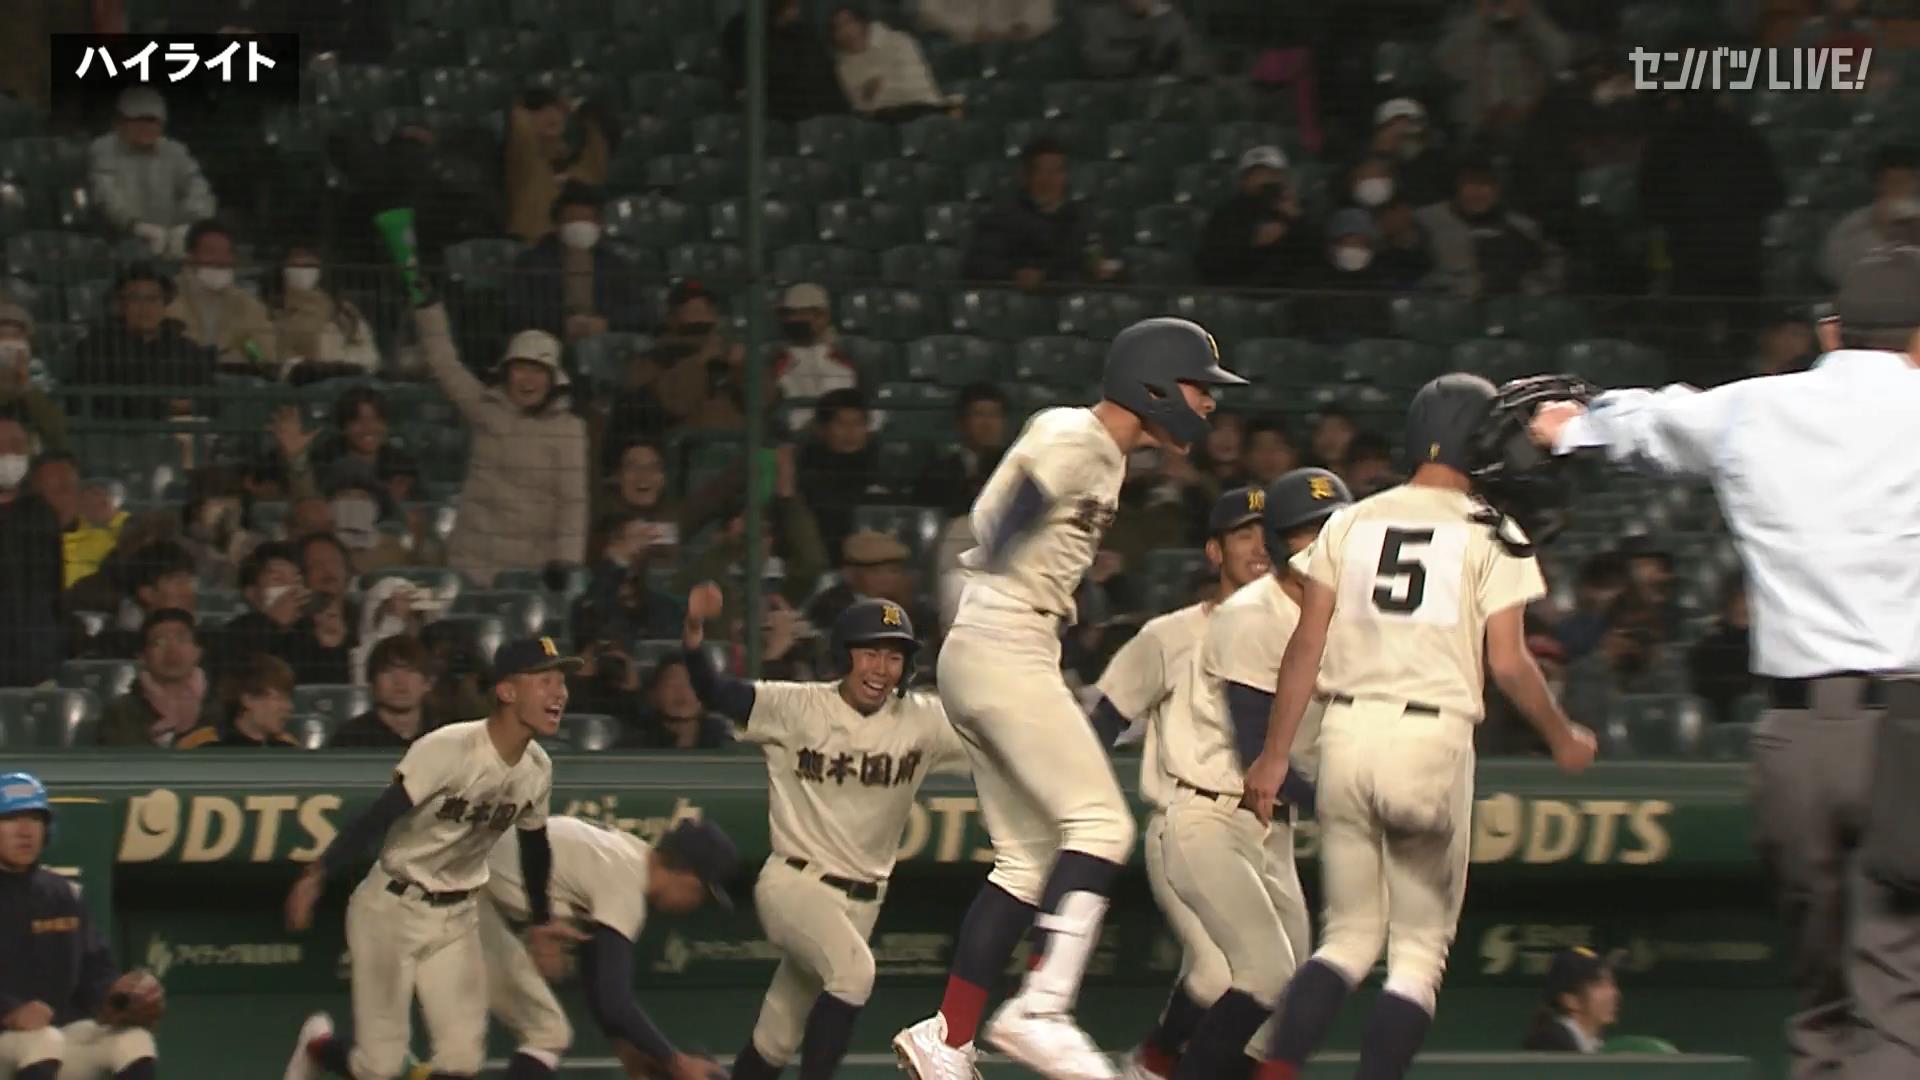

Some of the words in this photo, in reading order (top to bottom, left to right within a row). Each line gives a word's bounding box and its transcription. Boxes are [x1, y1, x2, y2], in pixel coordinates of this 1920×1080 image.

[1371, 526, 1435, 615] 5
[179, 795, 342, 863] DTS
[1525, 799, 1674, 864] DTS
